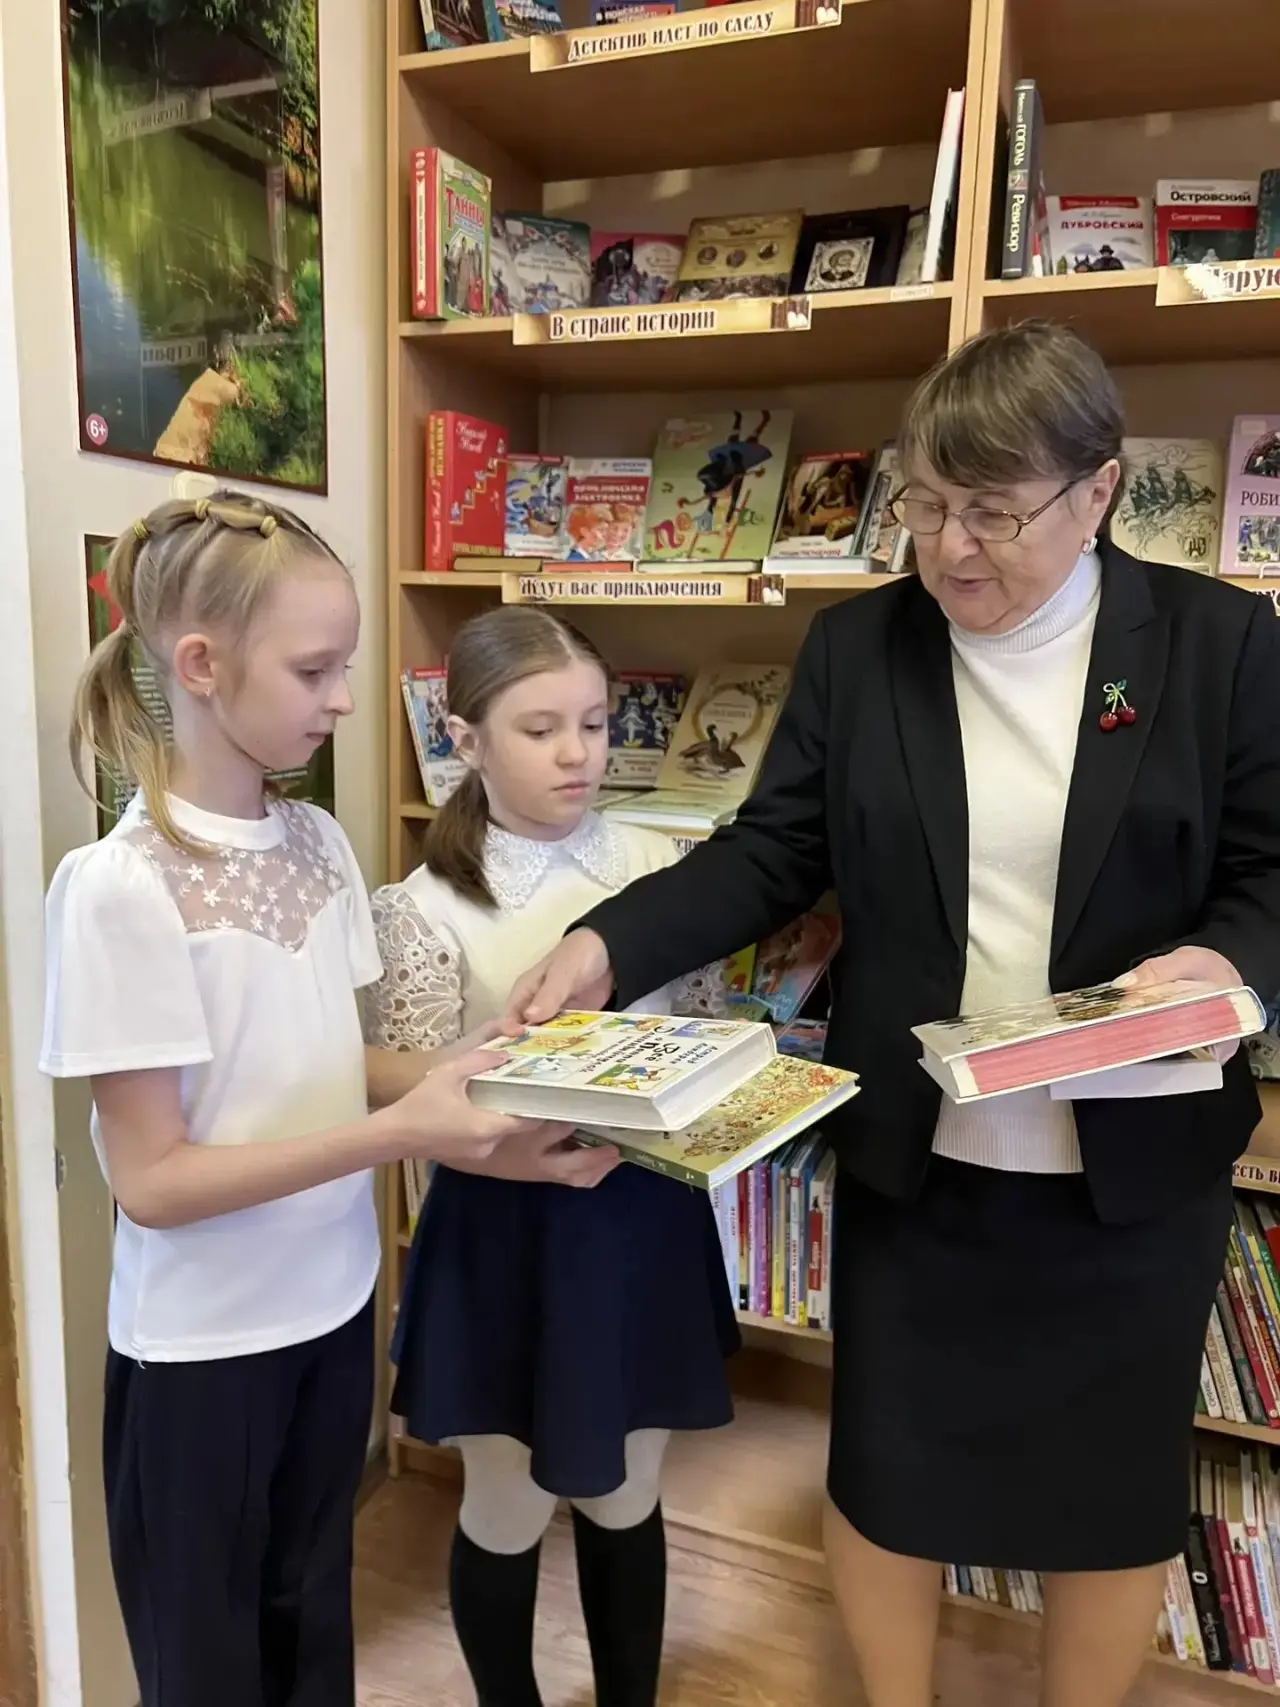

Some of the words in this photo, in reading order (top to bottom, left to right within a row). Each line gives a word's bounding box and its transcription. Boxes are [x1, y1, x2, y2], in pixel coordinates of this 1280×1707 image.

[571, 31, 648, 60] Детектив
[698, 20, 719, 33] по
[726, 11, 774, 32] следу
[1170, 190, 1251, 205] Островский
[1010, 192, 1026, 252] Ревизор
[1061, 220, 1144, 231] ДУБРОВСКИЙ
[552, 316, 564, 337] В
[569, 315, 632, 339] стране
[637, 310, 716, 334] истории
[90, 421, 106, 437] 6+
[520, 579, 563, 598] Ждут
[571, 581, 598, 595] вас
[604, 580, 722, 598] приключения
